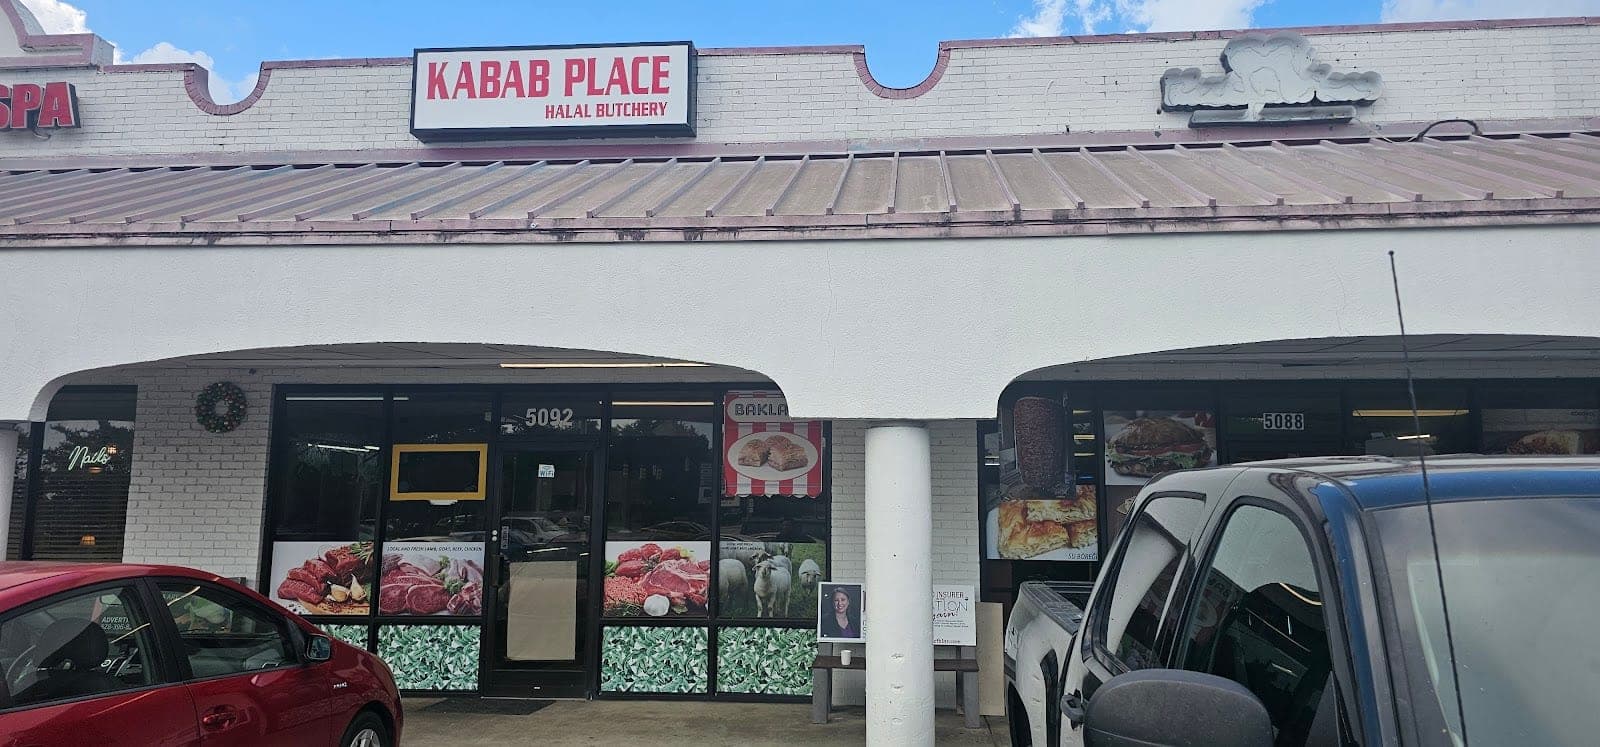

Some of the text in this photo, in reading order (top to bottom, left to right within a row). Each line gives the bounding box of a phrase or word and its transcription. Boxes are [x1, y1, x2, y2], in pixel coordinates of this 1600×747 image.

[427, 56, 670, 100] KABAB PLACE
[545, 102, 668, 119] HALAL BUTCHERY
[525, 408, 573, 426] 5092
[735, 403, 789, 416] BAKLA
[1264, 413, 1303, 429] 5088
[68, 445, 111, 471] Nails
[936, 591, 964, 599] INSURER
